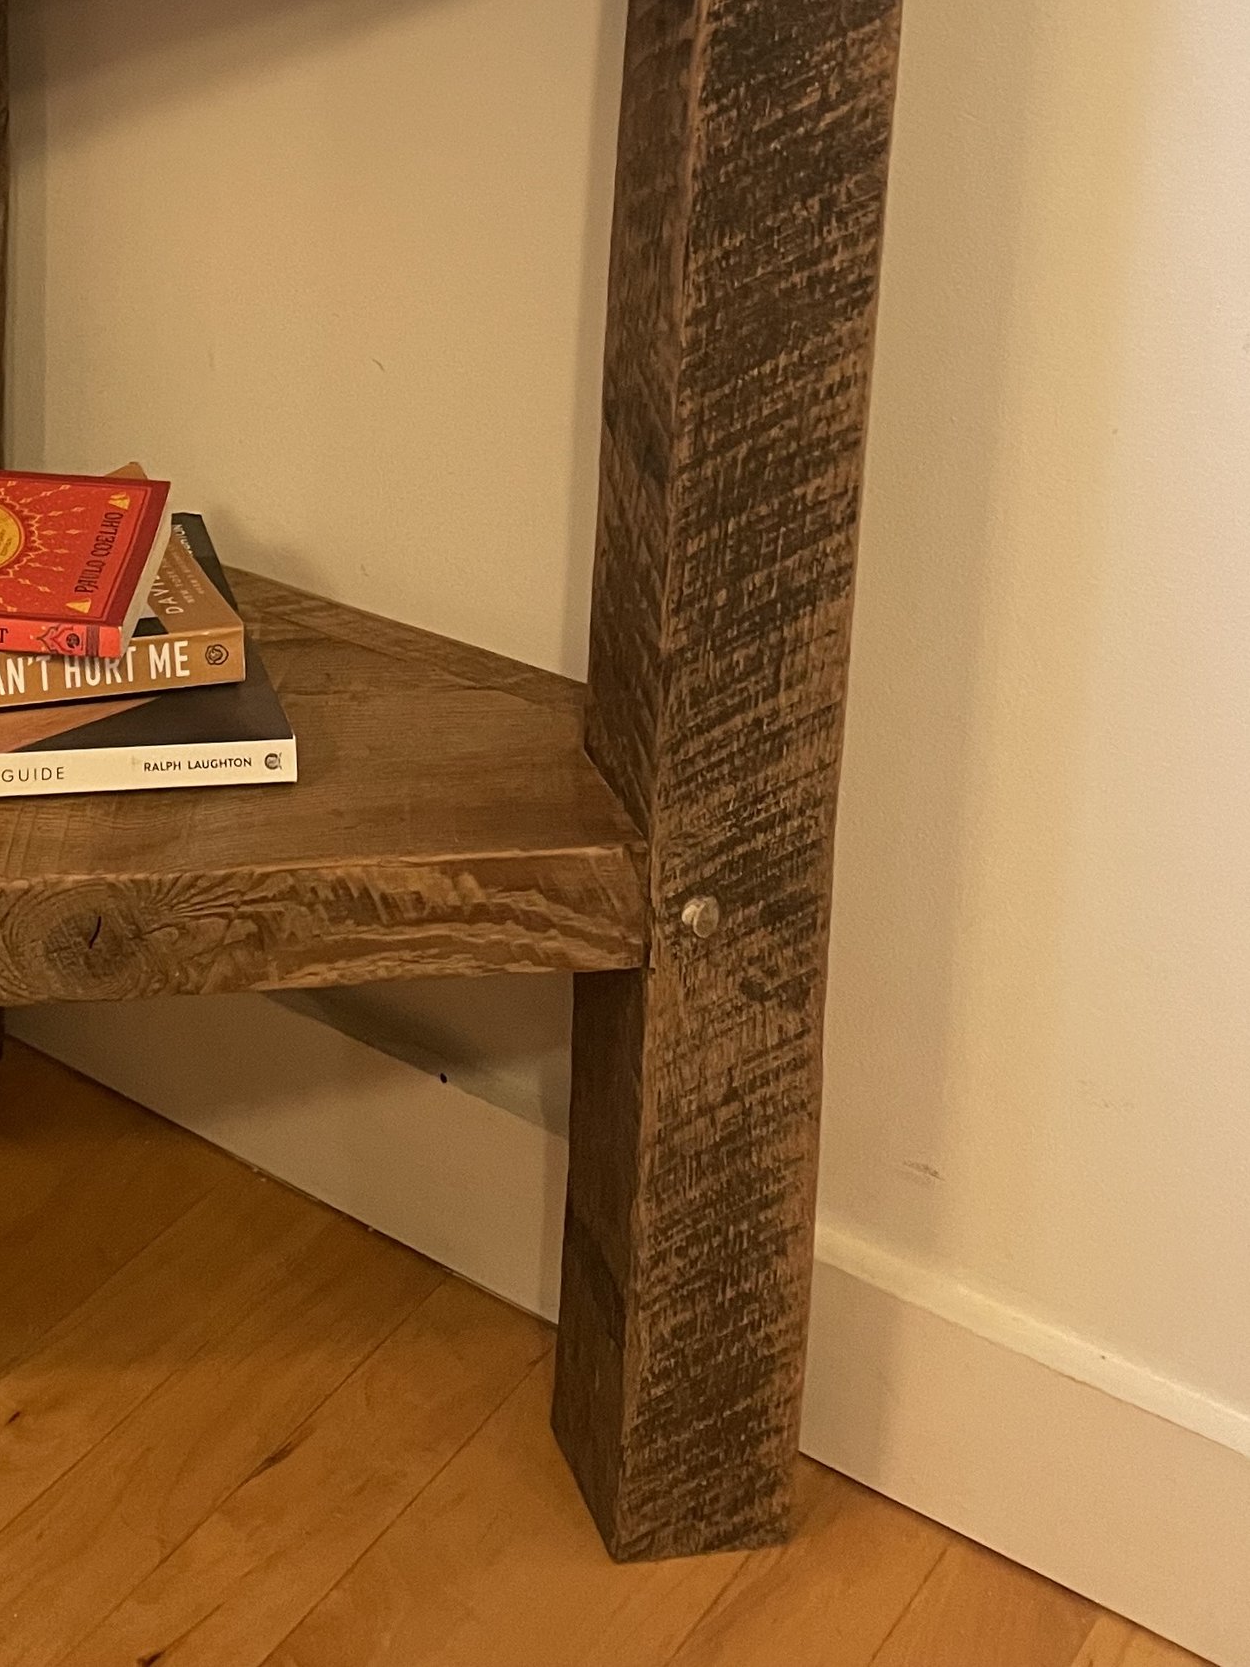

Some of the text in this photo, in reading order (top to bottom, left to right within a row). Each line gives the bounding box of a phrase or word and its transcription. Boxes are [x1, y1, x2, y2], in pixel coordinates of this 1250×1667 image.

[74, 512, 124, 593] PAULO COELHO
[64, 646, 136, 689] HURT
[148, 640, 190, 680] ME
[1, 766, 65, 783] GUIDE
[144, 757, 252, 772] RALPH LAUGHTON
